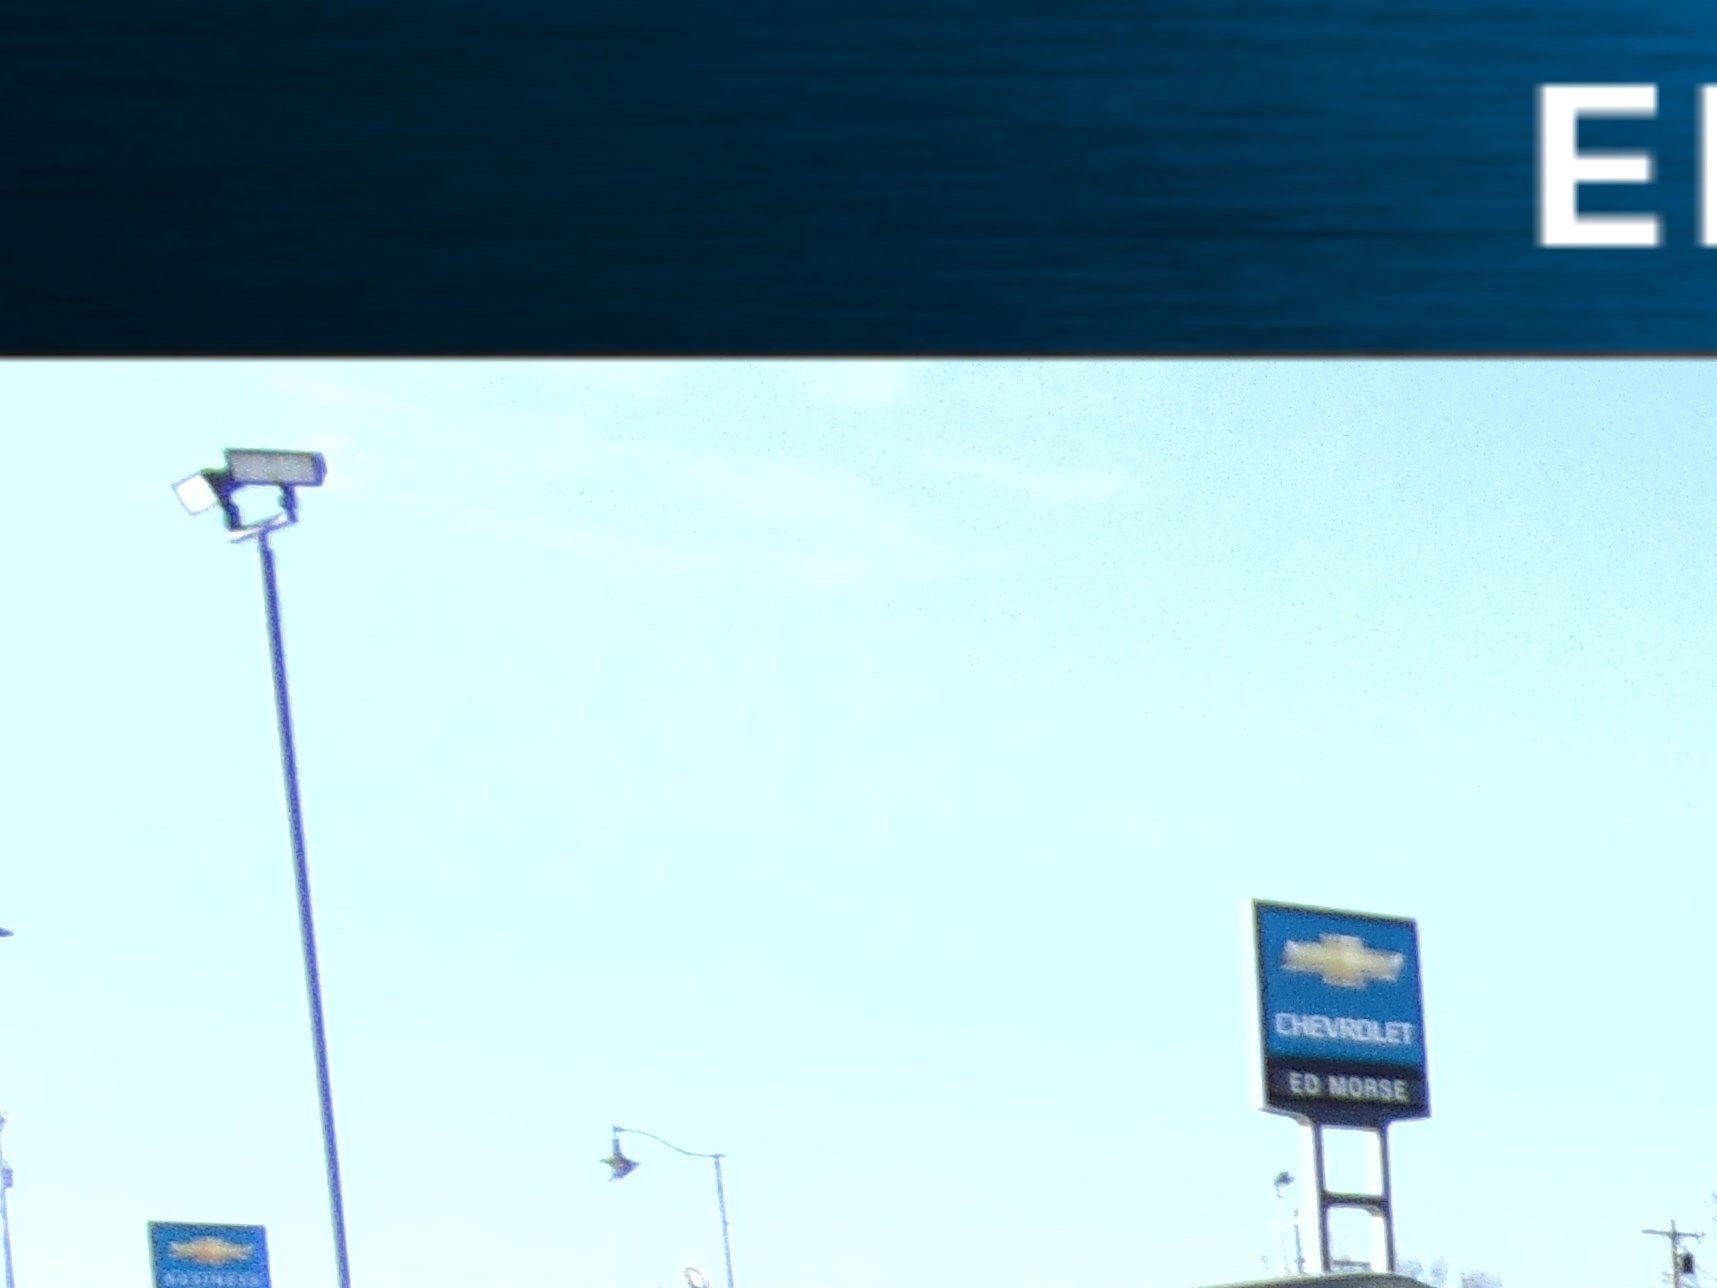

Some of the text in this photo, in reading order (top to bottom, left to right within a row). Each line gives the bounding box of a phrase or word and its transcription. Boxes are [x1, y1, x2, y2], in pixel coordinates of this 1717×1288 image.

[1275, 1012, 1414, 1045] CHEVROLET
[1288, 1071, 1409, 1102] ED MORSE
